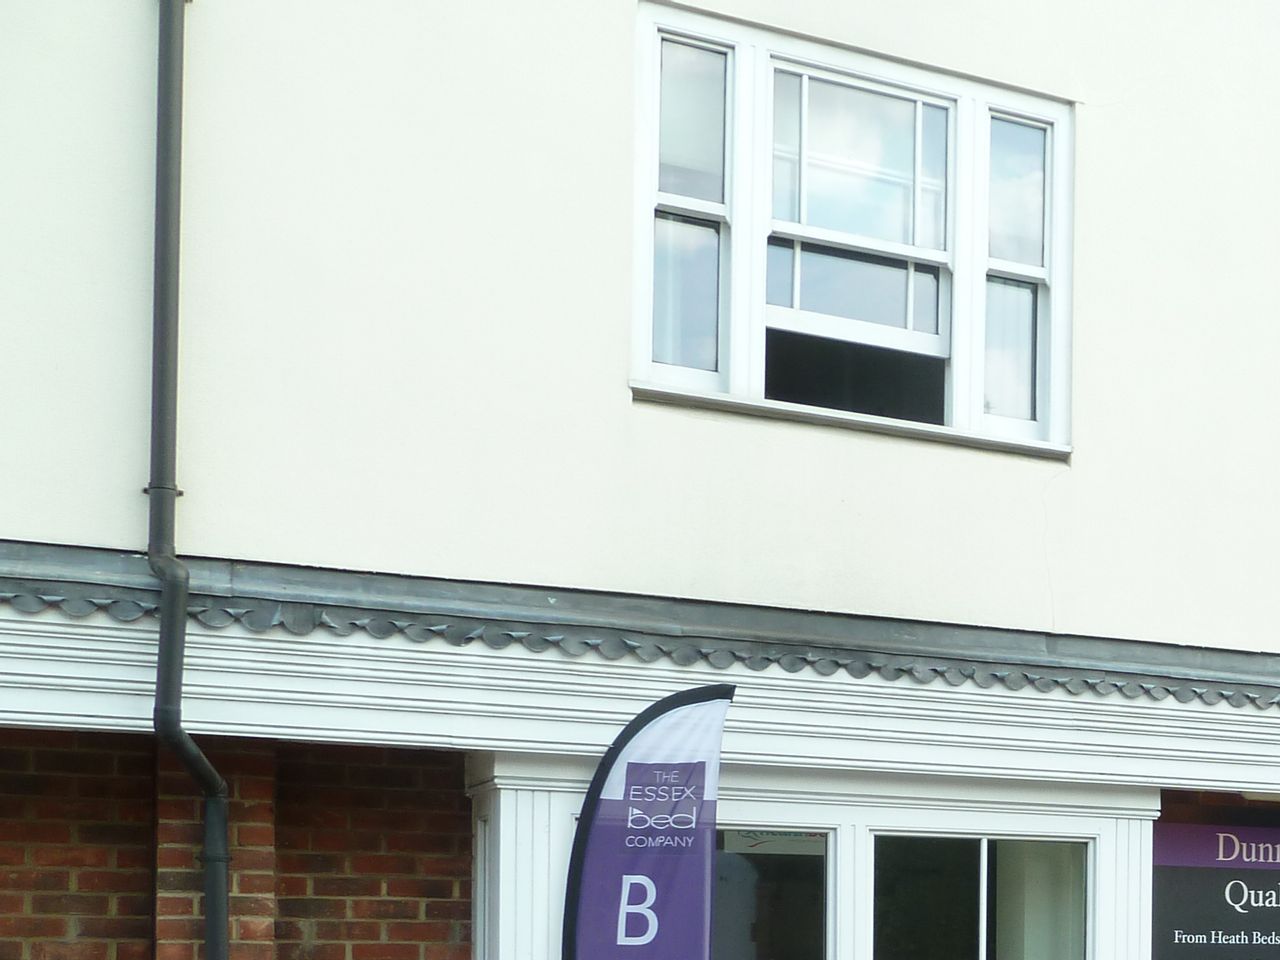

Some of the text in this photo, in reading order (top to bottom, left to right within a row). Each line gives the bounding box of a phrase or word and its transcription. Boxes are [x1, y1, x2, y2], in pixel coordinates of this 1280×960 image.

[653, 770, 680, 783] THE
[629, 785, 697, 801] ESSEX
[627, 806, 697, 830] bed
[625, 835, 695, 848] COMPANY
[1173, 929, 1207, 945] From
[1210, 930, 1249, 945] Heath
